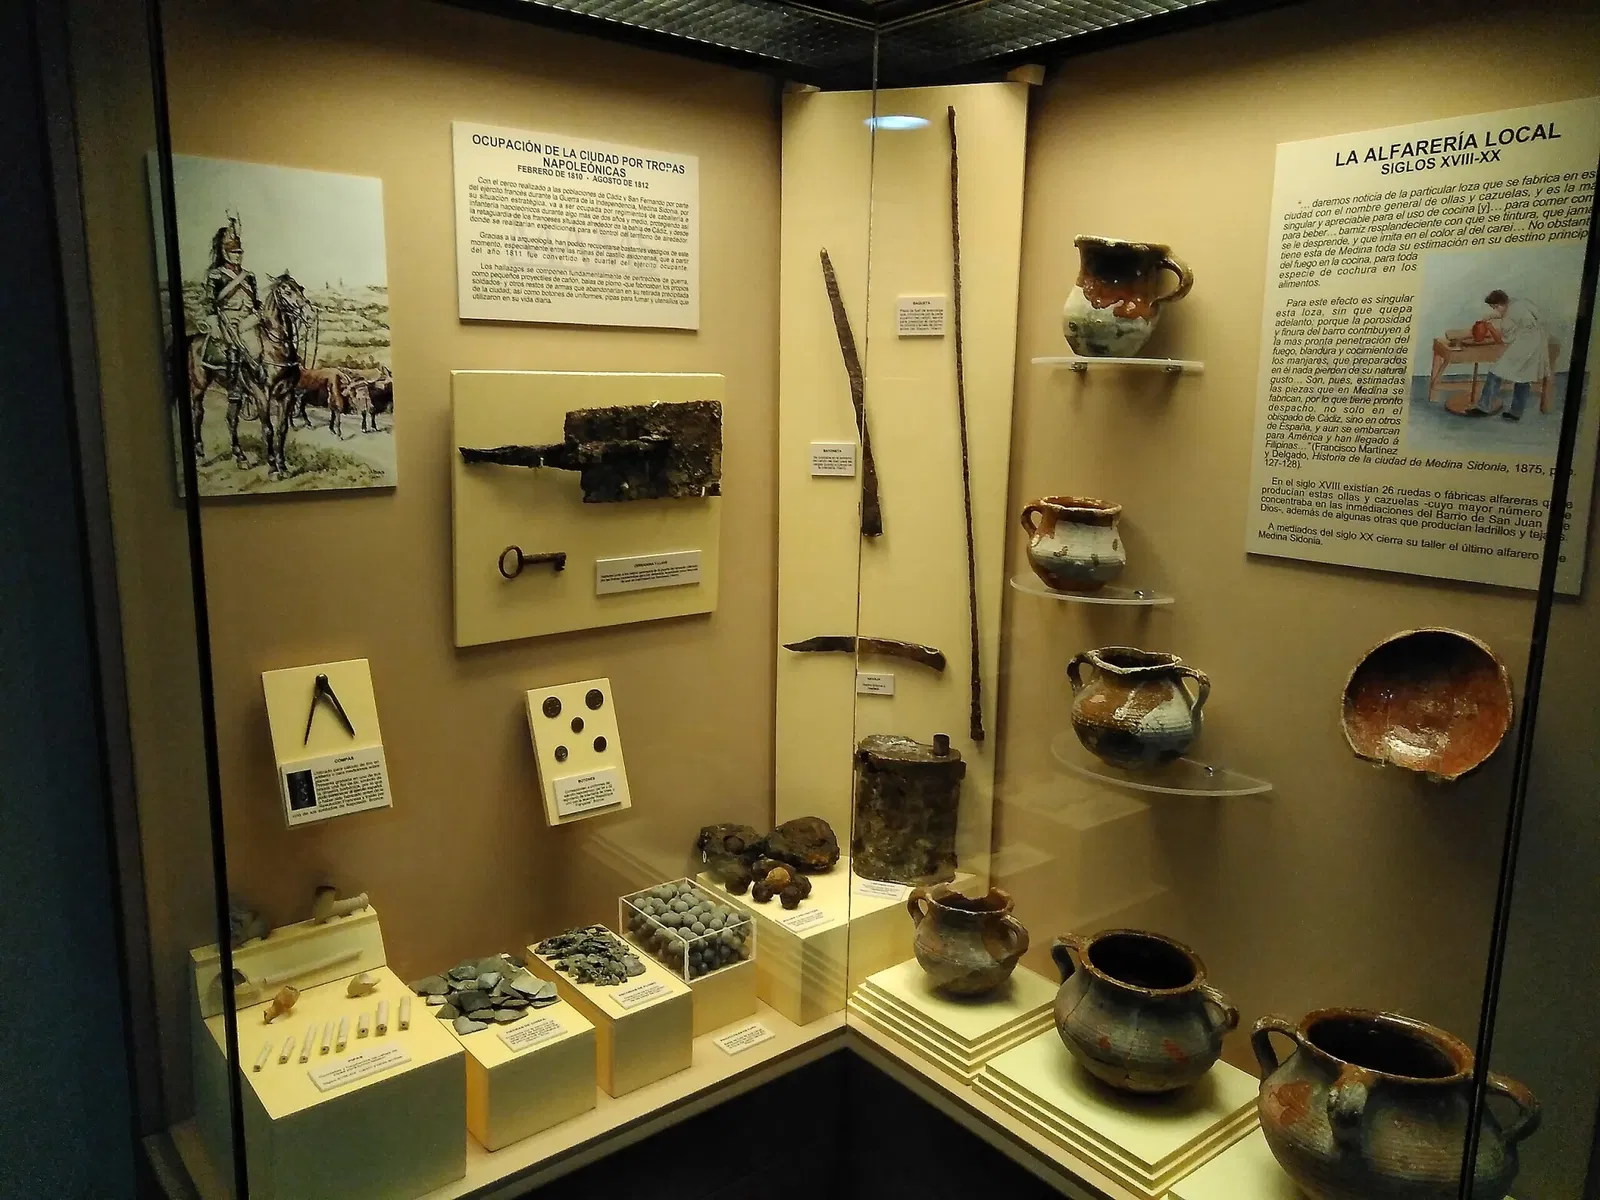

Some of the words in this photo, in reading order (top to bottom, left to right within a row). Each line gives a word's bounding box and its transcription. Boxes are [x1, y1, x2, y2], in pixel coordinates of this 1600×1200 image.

[472, 134, 542, 154] OCUPACIÓN
[544, 144, 560, 157] DE
[562, 147, 578, 159] LA
[579, 150, 620, 165] CIUDAD
[621, 156, 644, 168] POR
[645, 159, 685, 174] TROPAS
[1335, 150, 1359, 167] LA
[1364, 133, 1478, 162] ALFARERÍA
[1485, 123, 1561, 147] LOCAL
[543, 157, 626, 178] NAPOLEÓNICAS
[1381, 158, 1436, 175] SIGLOS
[1440, 150, 1501, 168] XVIII-XX
[517, 165, 554, 177] FEBRERO
[554, 169, 566, 179] DE
[567, 171, 584, 181] 1810
[592, 175, 622, 186] AGOSTO
[622, 178, 633, 187] DE
[634, 180, 650, 189] 1812
[1311, 197, 1351, 208] daremos
[1352, 192, 1383, 204] noticia
[1408, 185, 1457, 200] particular
[1457, 182, 1481, 193] loza
[1521, 174, 1561, 186] fabrica
[1282, 220, 1317, 231] singular
[1324, 214, 1371, 228] apreciable
[1371, 213, 1394, 224] para
[1441, 205, 1476, 216] cocina
[1503, 201, 1530, 213] para
[1532, 197, 1569, 208] comer
[1283, 209, 1314, 221] ciudad
[1345, 203, 1382, 215] nombre
[1383, 198, 1423, 213] general
[1440, 195, 1467, 205] ollas
[1281, 232, 1302, 242] para
[1338, 225, 1367, 236] barniz
[1367, 219, 1443, 234] resplandeciente
[1379, 232, 1403, 242] imita
[1429, 228, 1456, 238] color
[1280, 250, 1302, 260] tiene
[1303, 248, 1323, 258] esta
[1338, 245, 1373, 255] Medina
[1374, 243, 1397, 253] toda
[1413, 238, 1469, 250] estimación
[1504, 232, 1546, 244] destino
[1278, 269, 1315, 280] especie
[1336, 266, 1378, 276] cochura
[1293, 259, 1318, 269] fuego
[1373, 254, 1396, 265] para
[1396, 251, 1419, 262] toda
[1285, 298, 1307, 307] Para
[1308, 298, 1328, 307] este
[1330, 296, 1359, 306] efecto
[1375, 294, 1415, 306] singular
[1311, 451, 1347, 462] Historia
[1374, 455, 1408, 466] ciudad
[1425, 458, 1463, 469] Medina
[1261, 486, 1305, 499] producían
[1308, 490, 1334, 500] estas
[1336, 491, 1360, 502] ollas
[1374, 495, 1420, 507] cazuelas
[1423, 500, 1454, 512] -cuyo
[1457, 503, 1494, 515] mayor
[1498, 504, 1543, 517] número
[1295, 479, 1317, 491] siglo
[1317, 481, 1341, 491] XVIII
[1342, 483, 1379, 494] existían
[1396, 487, 1432, 498] ruedas
[1444, 490, 1486, 502] fábricas
[1489, 493, 1539, 506] alfareras
[1260, 495, 1313, 507] concentraba
[1345, 502, 1414, 516] inmediaciones
[1435, 509, 1468, 521] Barrio
[1514, 516, 1543, 528] Juan
[1286, 507, 1320, 517] además
[1335, 511, 1372, 523] algunas
[1373, 514, 1398, 525] otras
[1421, 518, 1472, 532] producían
[1474, 523, 1517, 536] ladrillos
[1258, 530, 1288, 541] Medina
[1276, 524, 1318, 536] mediados
[1335, 530, 1358, 541] siglo
[1375, 534, 1403, 545] cierra
[1420, 539, 1446, 550] taller
[1461, 543, 1494, 555] último
[1496, 547, 1540, 560] alfarero
